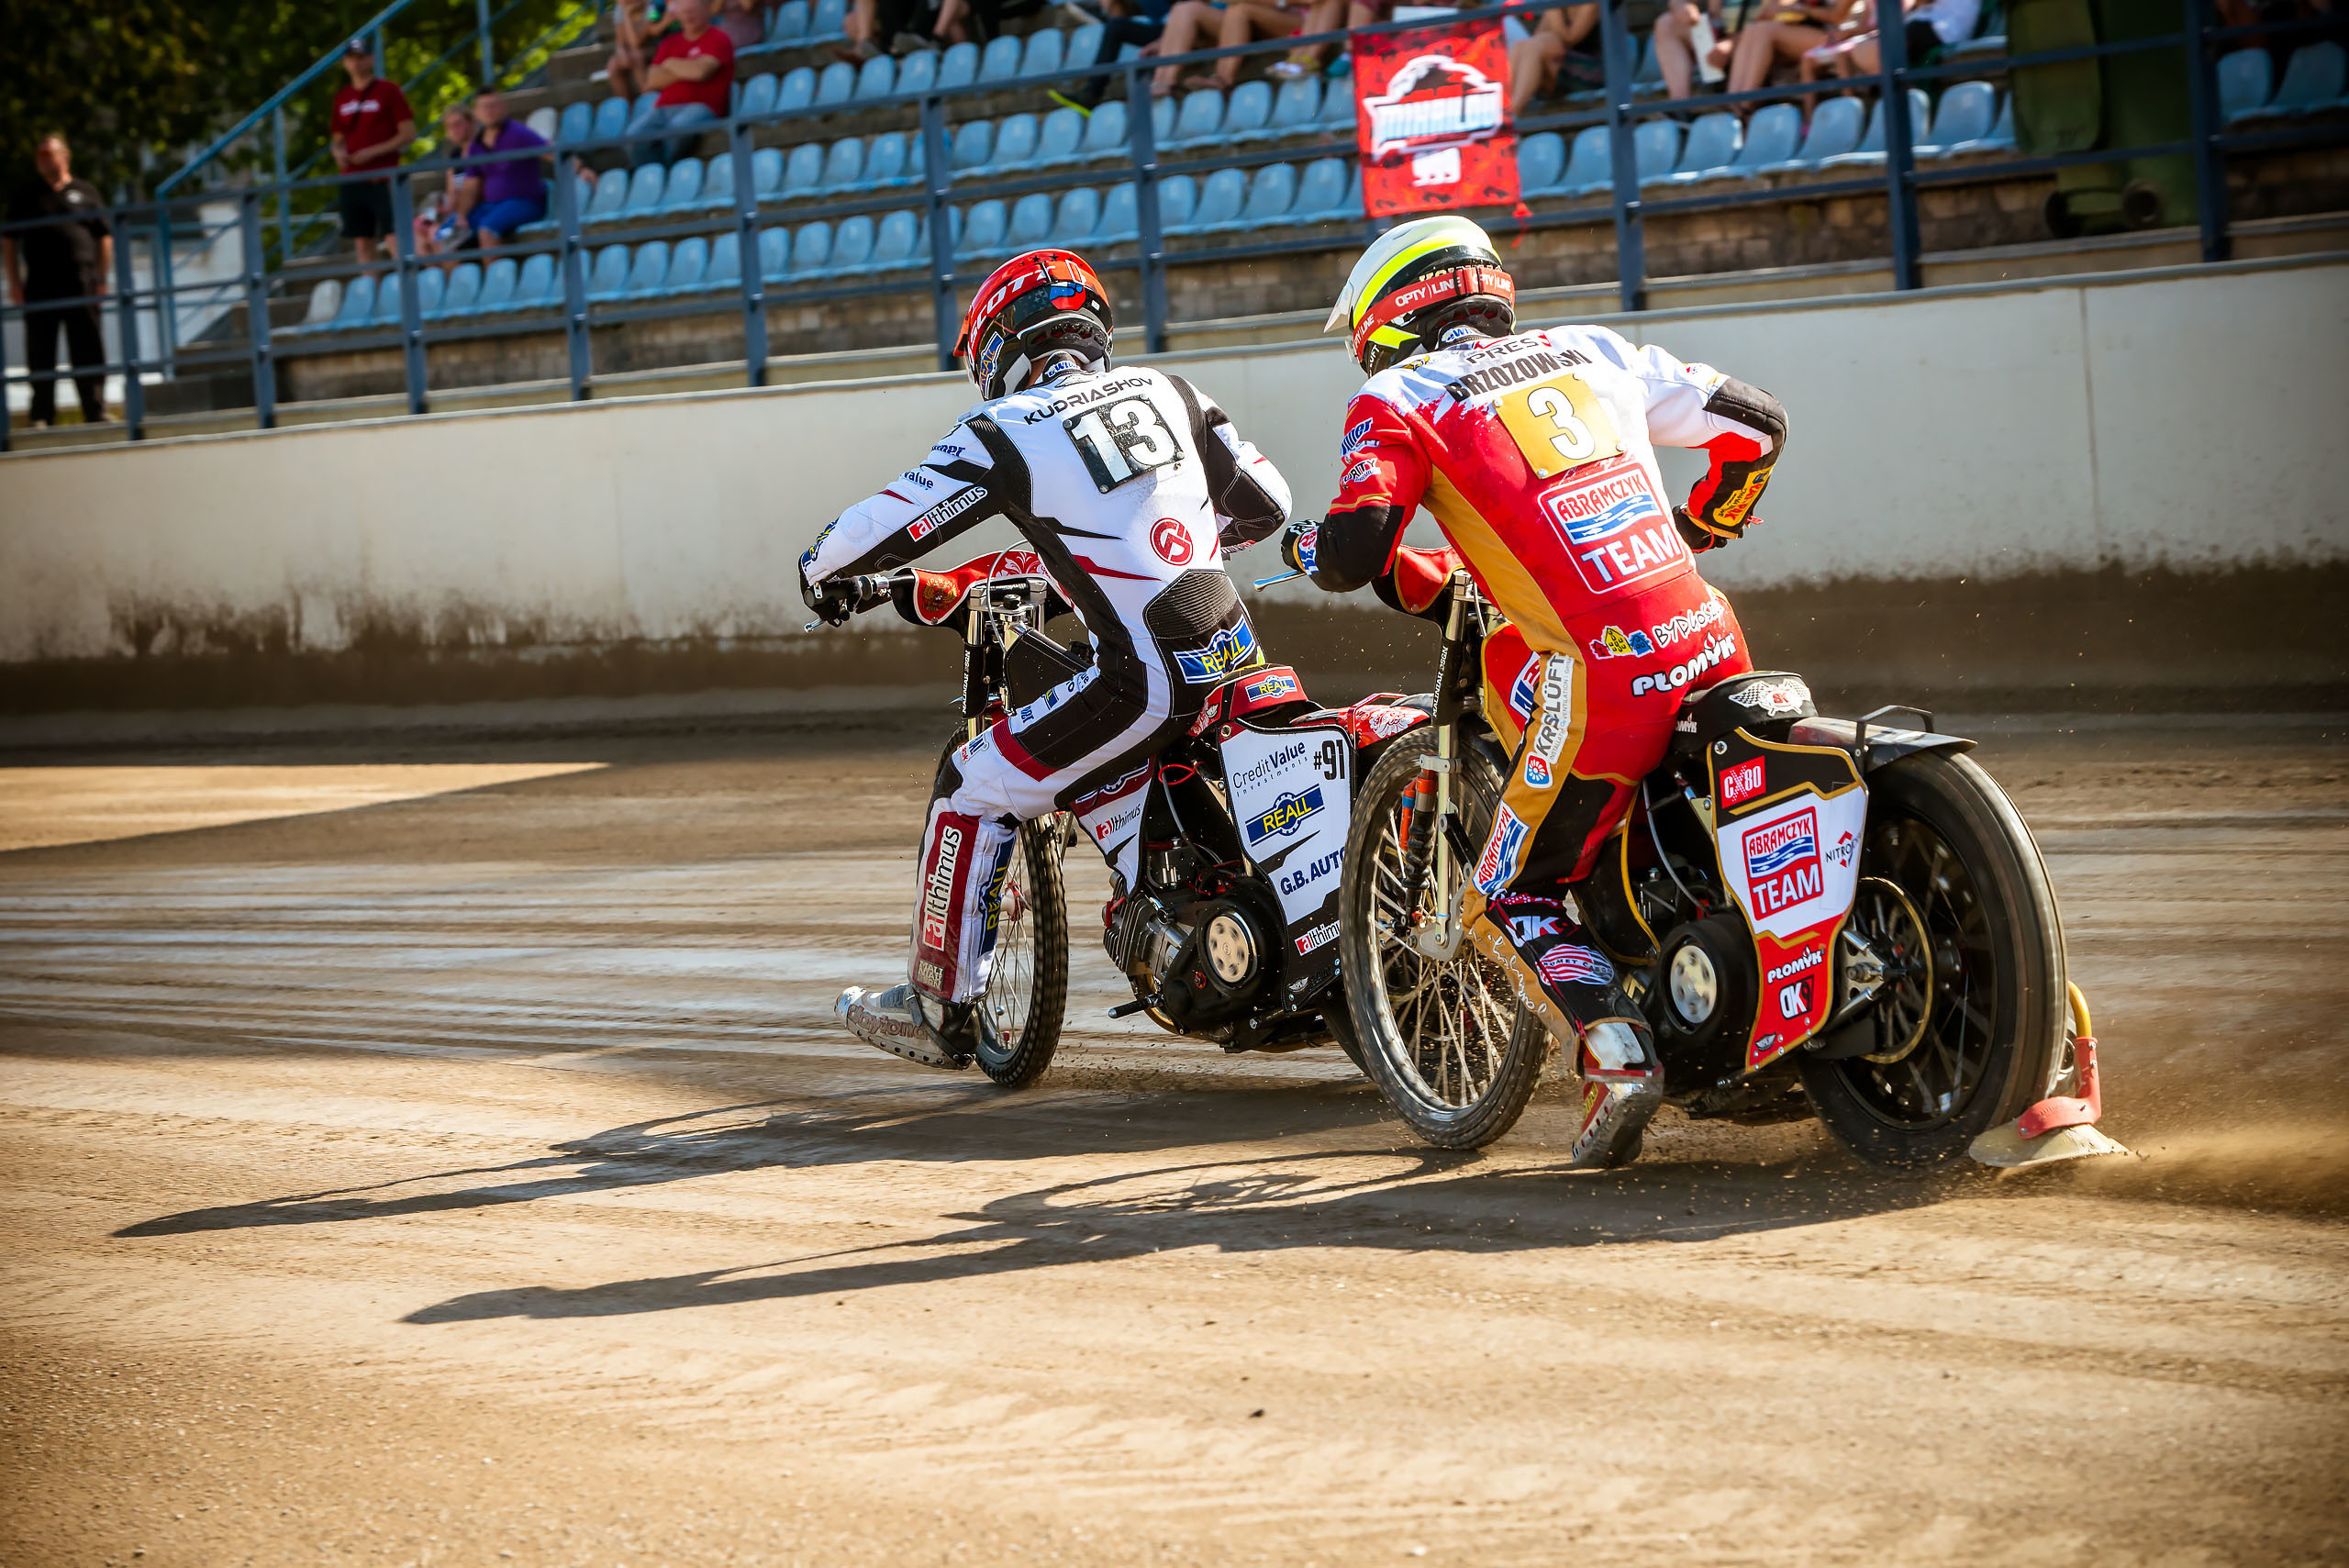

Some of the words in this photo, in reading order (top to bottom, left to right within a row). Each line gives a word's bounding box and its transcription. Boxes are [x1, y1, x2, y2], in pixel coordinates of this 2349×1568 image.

[1023, 376, 1152, 426] KUDRIASHOV
[1443, 350, 1593, 402] BRZOZOWSKI
[1072, 399, 1182, 484] 13
[1527, 386, 1596, 461] 3
[916, 486, 987, 537] althimus
[1557, 472, 1646, 522] ABRAMCZYK
[1580, 523, 1681, 584] TEAM
[1201, 636, 1245, 673] REALL
[1259, 680, 1290, 695] REALL
[1313, 739, 1346, 781] #91
[1724, 765, 1762, 801] CX80
[1101, 804, 1141, 838] althimus
[1263, 797, 1312, 833] REALL
[1749, 816, 1812, 857] ABRAMCZYK
[1478, 806, 1512, 885] ABRAMCZYK
[926, 827, 960, 937] althimus
[985, 858, 1010, 932] REALL
[1753, 863, 1821, 915] TEAM
